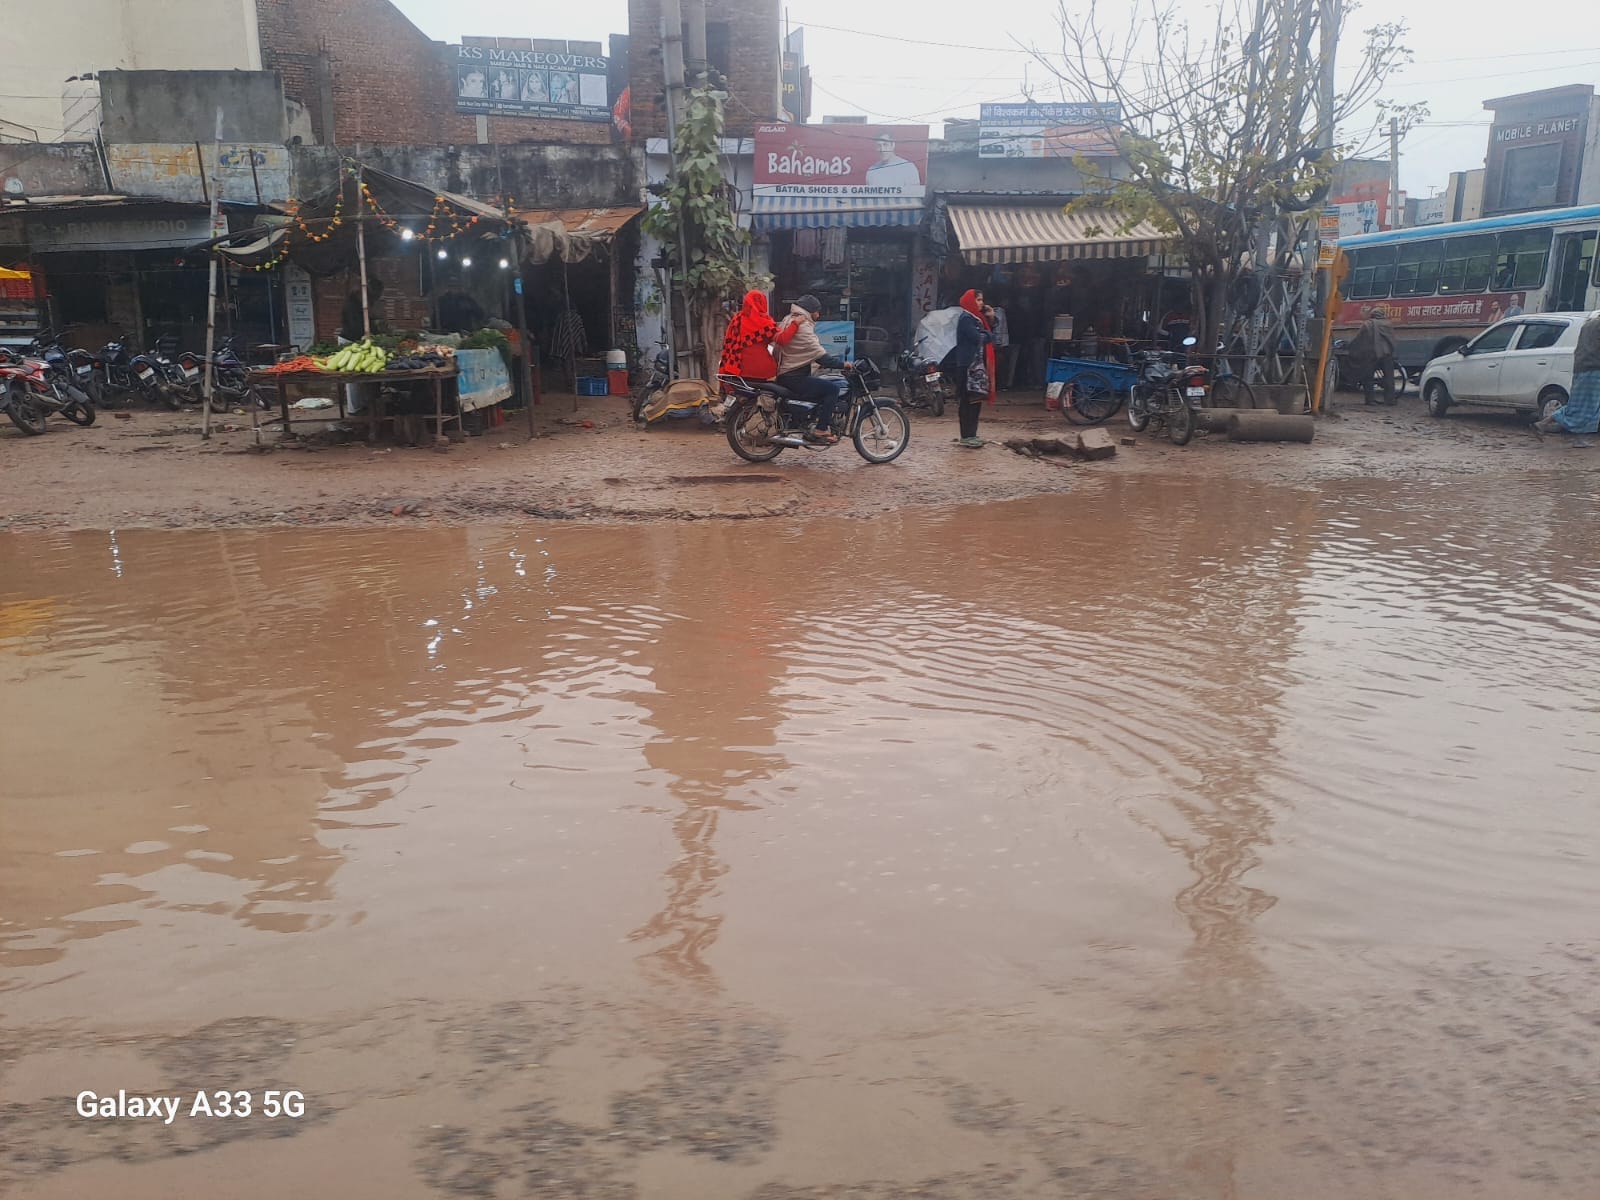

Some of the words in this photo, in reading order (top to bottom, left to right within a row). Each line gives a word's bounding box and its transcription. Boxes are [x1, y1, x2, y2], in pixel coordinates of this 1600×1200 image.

[457, 46, 483, 60] KS
[488, 48, 608, 69] MAKEOVERS
[1496, 126, 1532, 142] MOBILE
[1537, 119, 1578, 135] PLANET
[768, 150, 852, 176] Bahamas
[775, 185, 806, 194] BATRA
[807, 185, 839, 194] SHOES
[841, 185, 849, 194] &
[850, 185, 902, 195] GARMENTS
[1407, 305, 1421, 317] आप
[1422, 305, 1442, 316] सादर
